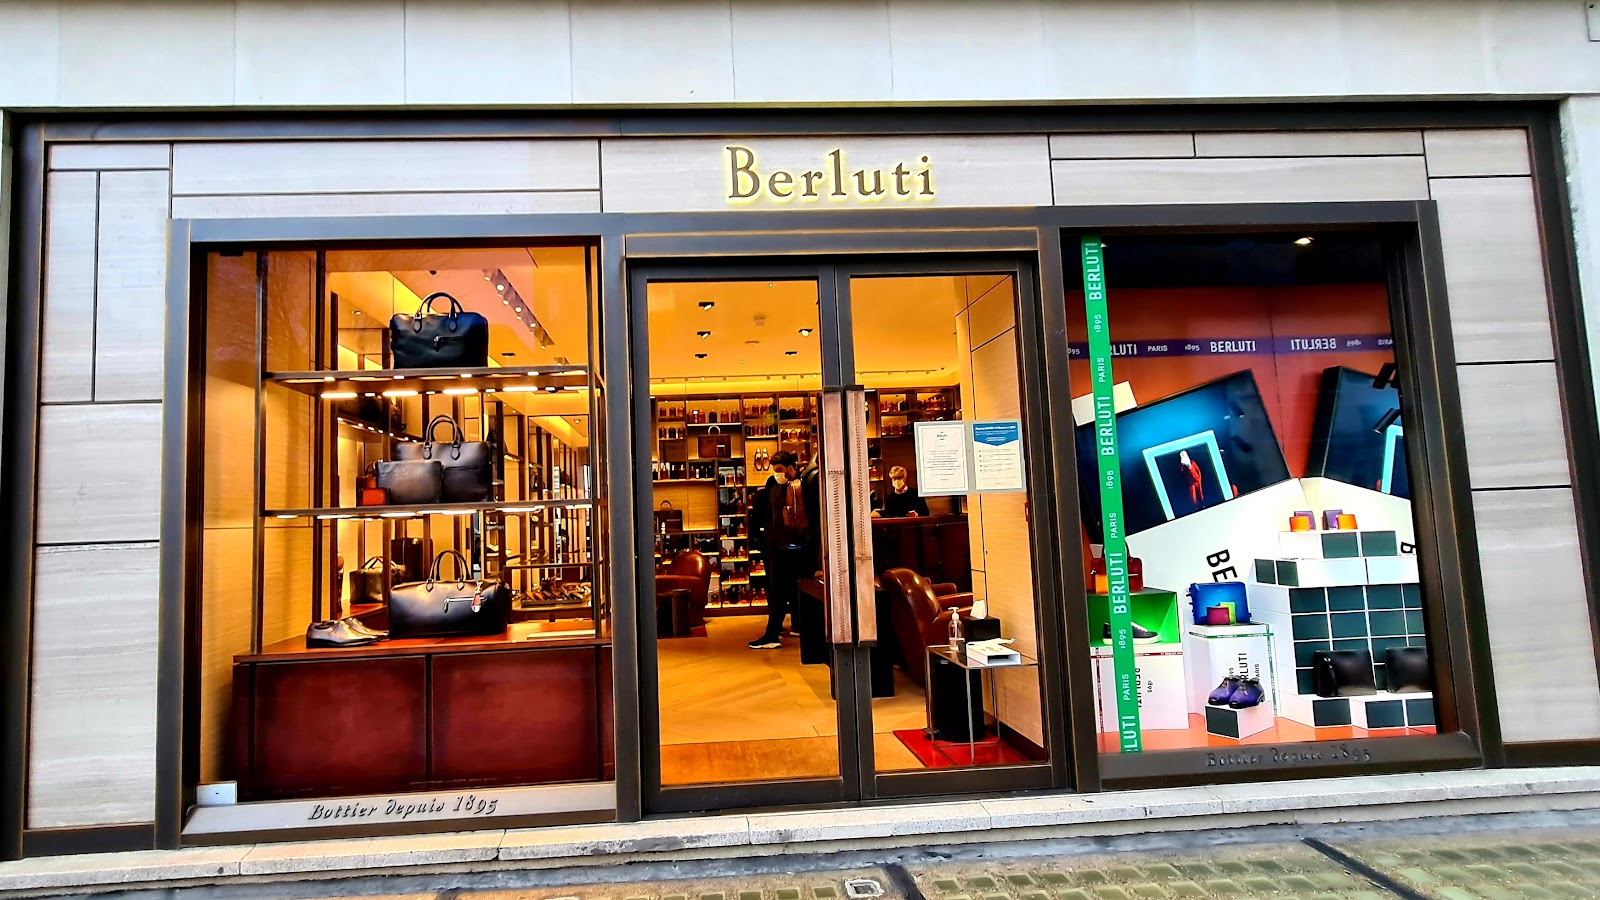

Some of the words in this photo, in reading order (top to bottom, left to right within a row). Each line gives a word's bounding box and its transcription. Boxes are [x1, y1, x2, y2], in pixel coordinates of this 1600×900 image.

[726, 146, 935, 199] Berluti
[1085, 242, 1103, 301] BERLUTI
[1094, 314, 1102, 333] 1895
[1147, 344, 1169, 352] PARIS
[1184, 343, 1201, 352] 1895
[1209, 340, 1257, 353] BERLUTI
[1097, 357, 1105, 383] PARIS
[1097, 396, 1115, 456] BERLUTI
[1106, 469, 1115, 490] 1895
[1109, 512, 1119, 539] PARIS
[1109, 552, 1128, 615] BERLUTI
[1118, 629, 1127, 650] 1895
[1121, 673, 1131, 701] PARIS
[1122, 715, 1138, 752] LUTI
[307, 803, 378, 821] Bottier
[384, 798, 446, 819] depuis
[452, 794, 499, 816] 1895
